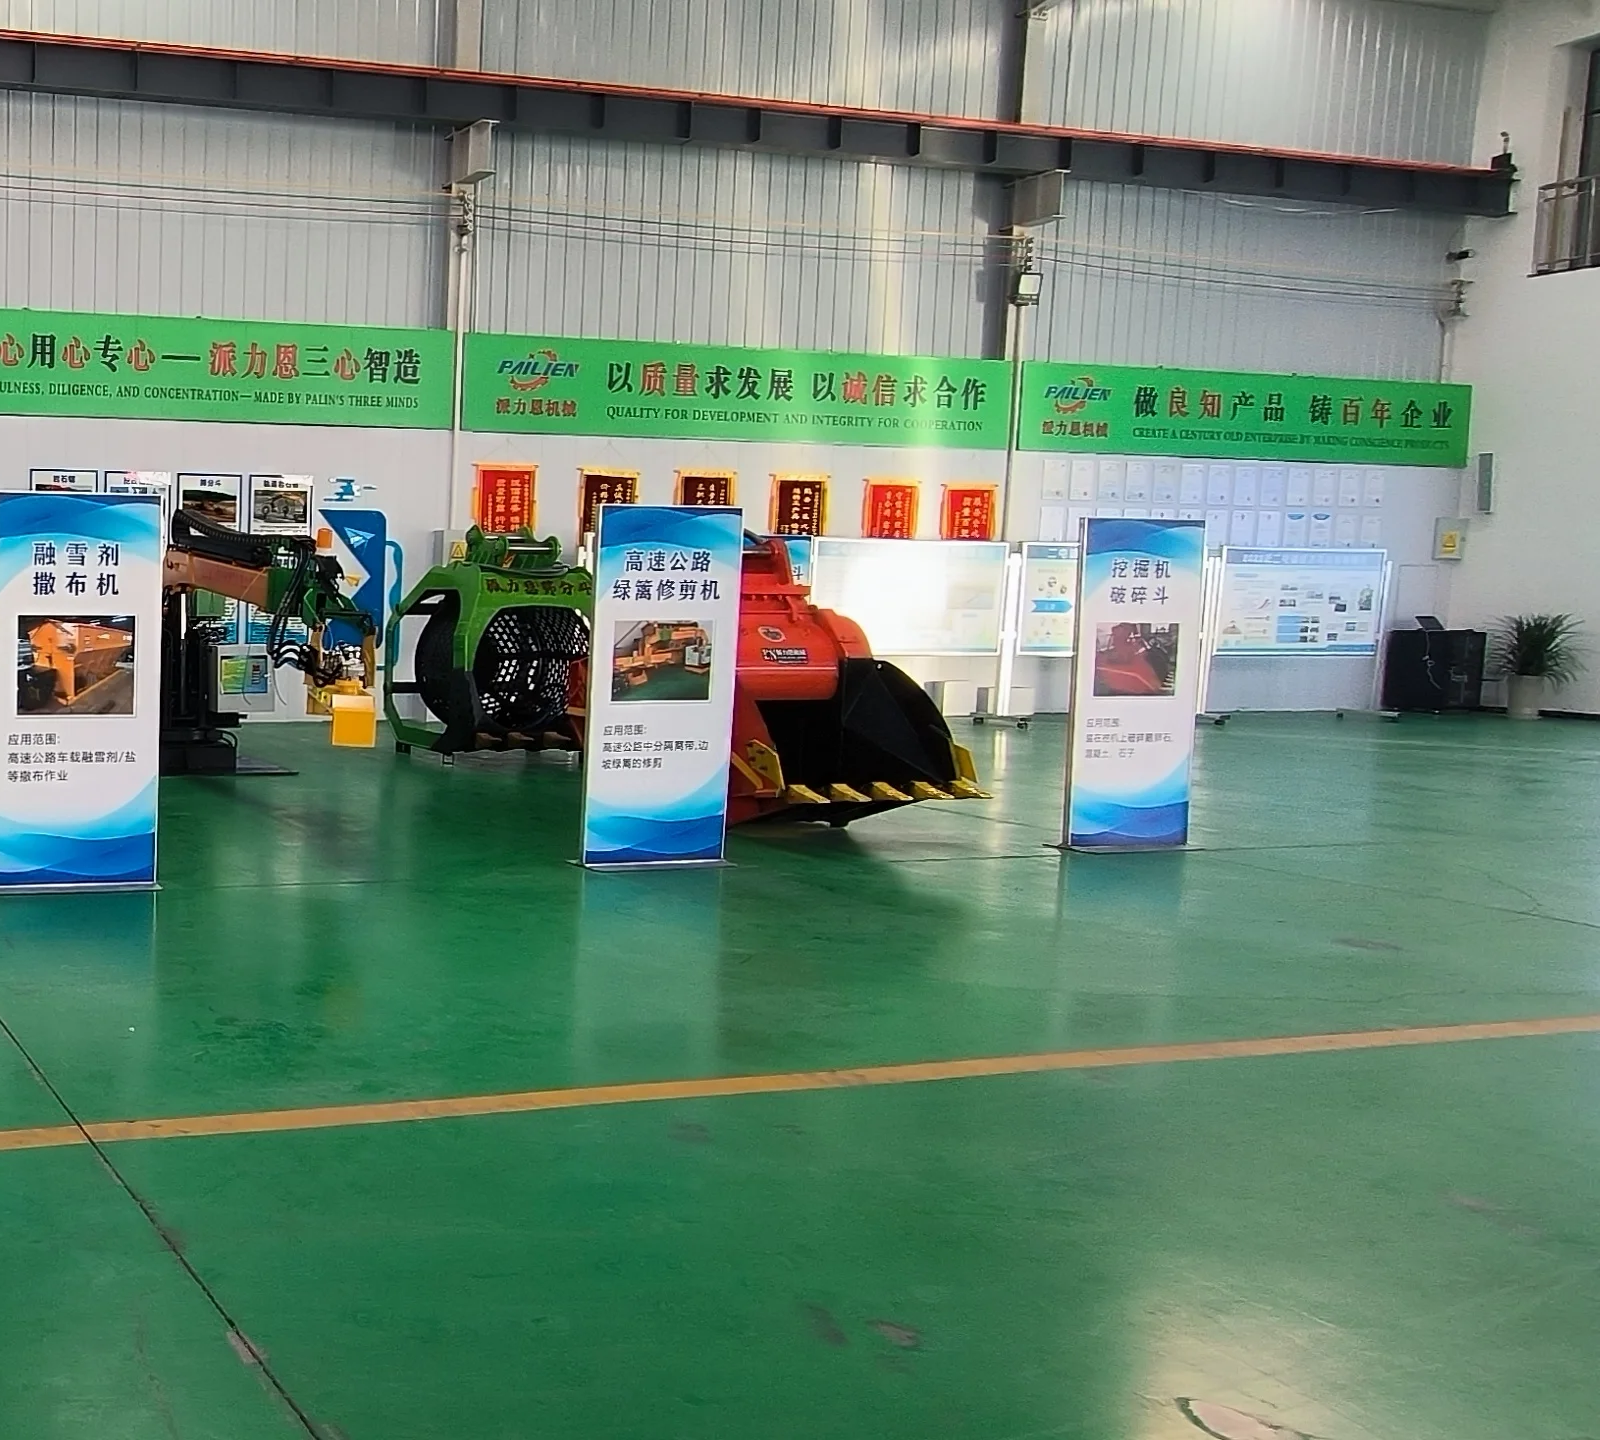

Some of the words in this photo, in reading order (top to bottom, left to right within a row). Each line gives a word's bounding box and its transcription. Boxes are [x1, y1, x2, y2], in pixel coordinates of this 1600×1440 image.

[49, 383, 112, 399] DILIGENCE,
[116, 386, 140, 398] AND
[287, 392, 301, 405] BY
[305, 393, 345, 407] PALIN'S
[349, 394, 382, 408] THREE
[386, 396, 419, 409] MINDS
[607, 362, 794, 401] 以质量求发展
[812, 371, 988, 411] 以诚信求合作
[496, 398, 577, 418] 派力恩机械
[607, 406, 660, 419] QUALITY
[664, 408, 688, 420] FOR
[692, 409, 779, 424] DEVELOPMENT
[783, 413, 808, 425] AND
[812, 415, 873, 428] INTEGRITY
[877, 417, 900, 428] FOR
[903, 419, 983, 432] COOPERATION
[1134, 385, 1285, 422] 做良知产品
[1309, 395, 1453, 429] 铸百年企业
[32, 542, 120, 568] 融雪剂
[624, 550, 712, 573] 高速公路
[1111, 558, 1171, 580] 挖掘机
[32, 572, 120, 598] 撒布机
[612, 578, 721, 601] 绿篱修剪机
[1109, 585, 1170, 605] 破碎斗
